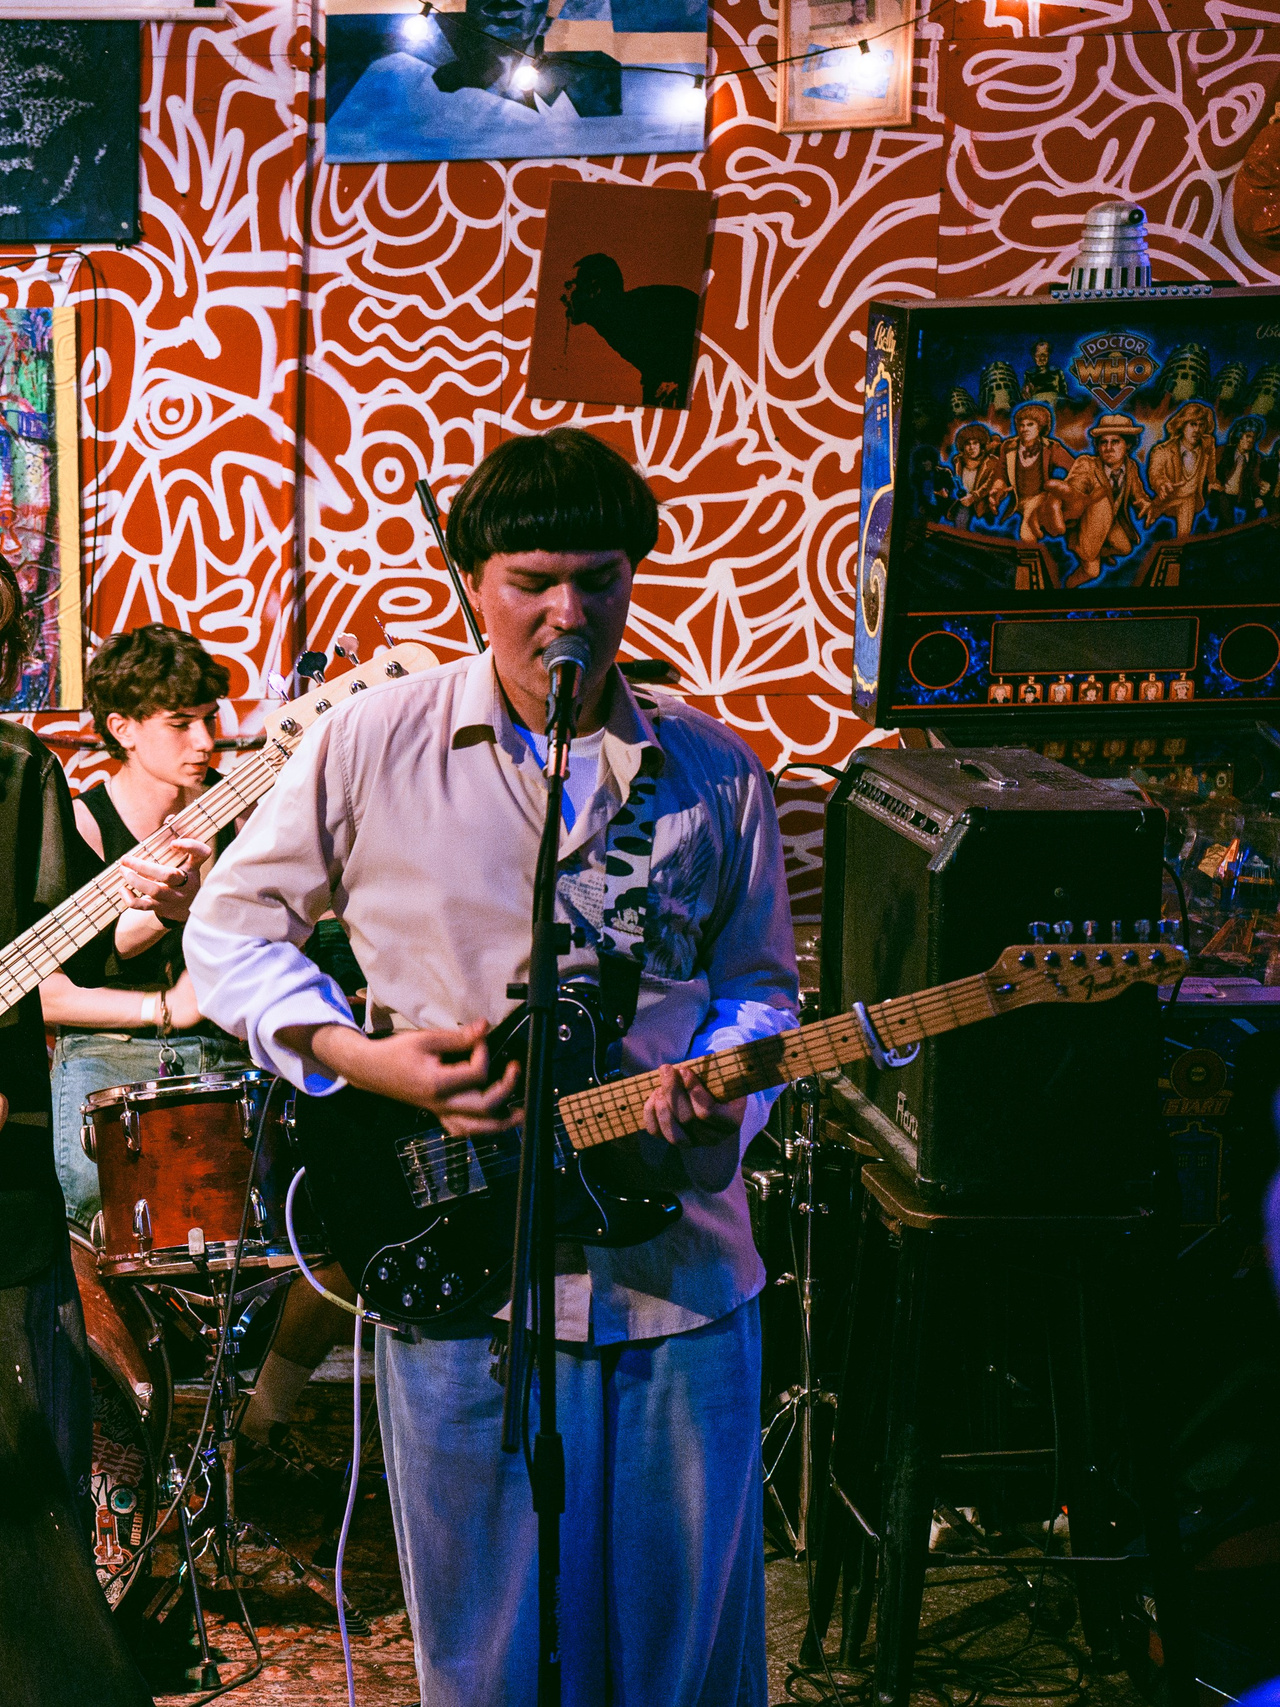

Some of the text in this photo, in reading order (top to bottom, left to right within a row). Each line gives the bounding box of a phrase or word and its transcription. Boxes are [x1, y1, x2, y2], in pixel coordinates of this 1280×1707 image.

[1086, 336, 1145, 354] DOCTOR
[1074, 356, 1153, 384] WHO
[998, 672, 1187, 685] 1 2 3 4 5 6 7
[1166, 1098, 1225, 1114] START
